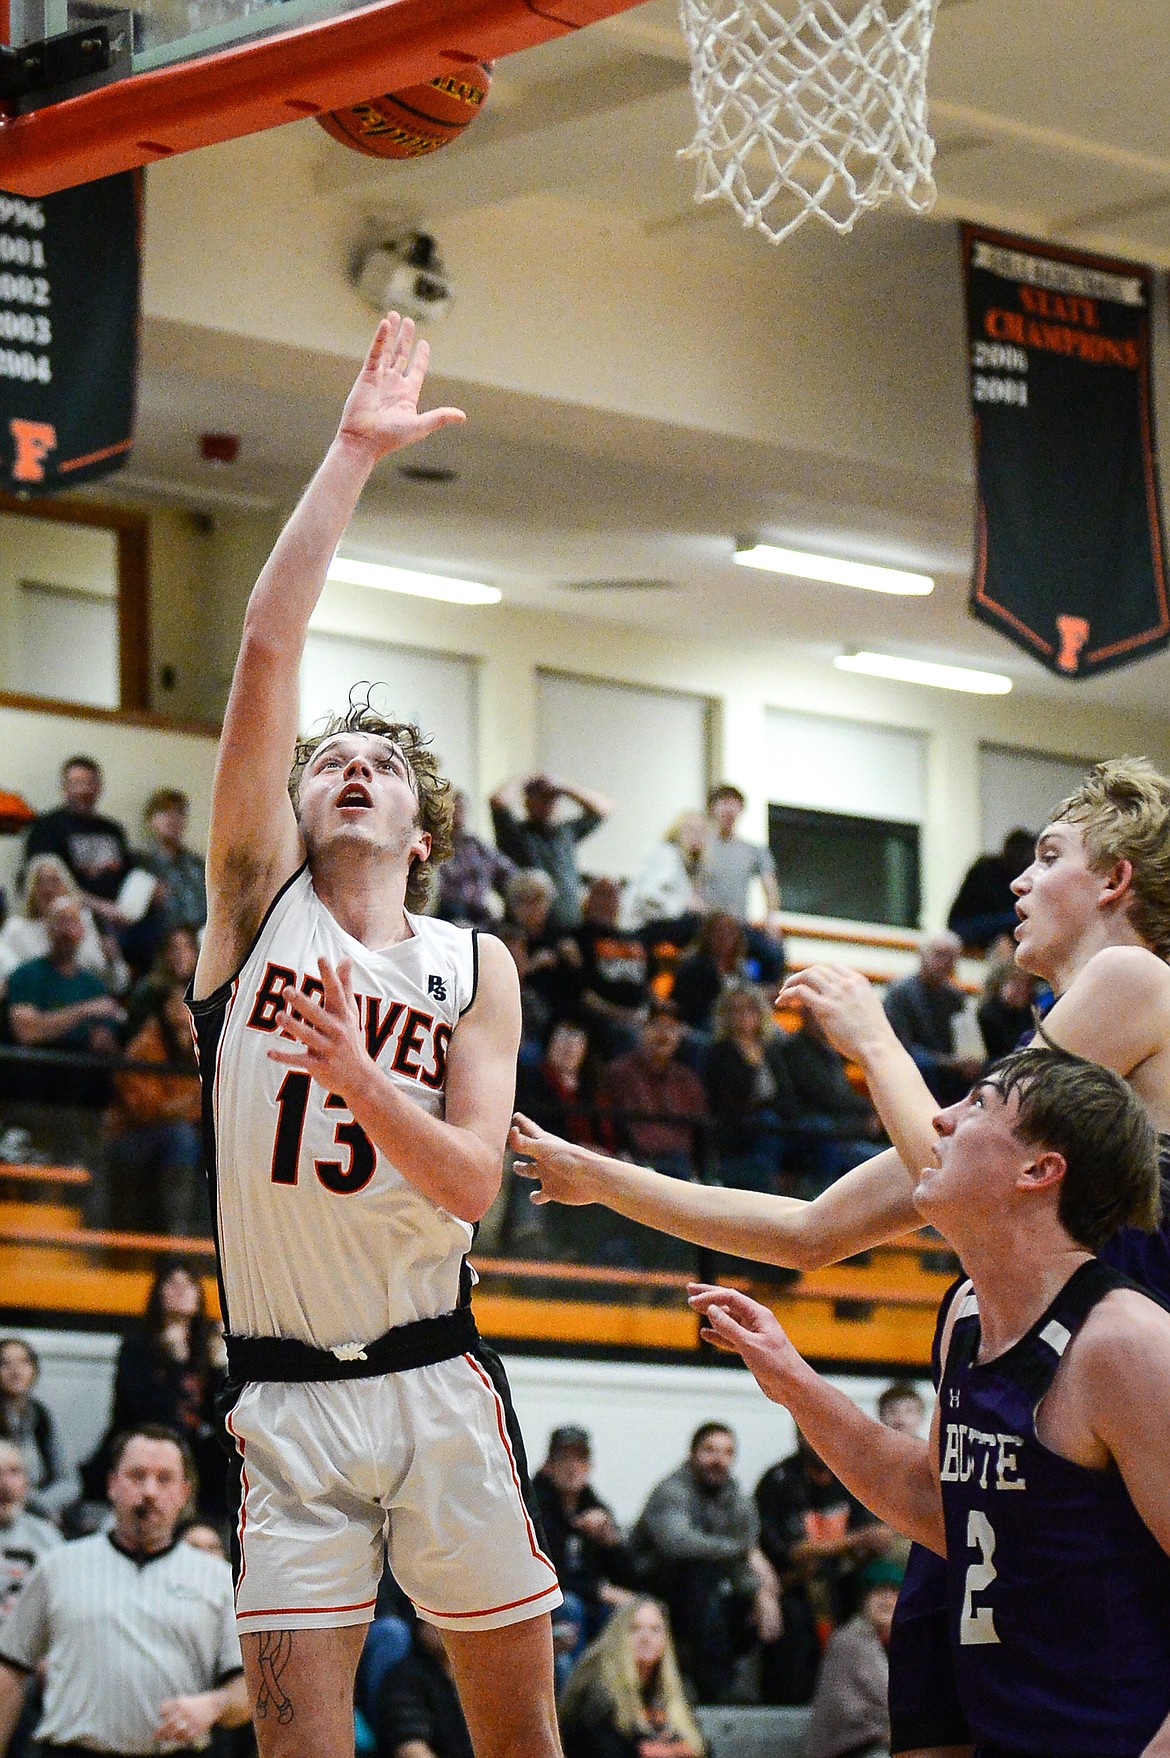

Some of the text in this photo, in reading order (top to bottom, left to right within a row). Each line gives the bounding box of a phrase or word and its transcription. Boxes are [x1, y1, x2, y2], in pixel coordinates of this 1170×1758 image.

[0, 233, 46, 268] 001
[0, 271, 51, 305] 002
[0, 310, 51, 346] 003
[984, 306, 1140, 369] CHAMPIONS
[9, 418, 57, 481] F
[246, 962, 452, 1089] BRVES
[270, 1070, 378, 1195] 13
[960, 1510, 1001, 1645] 2
